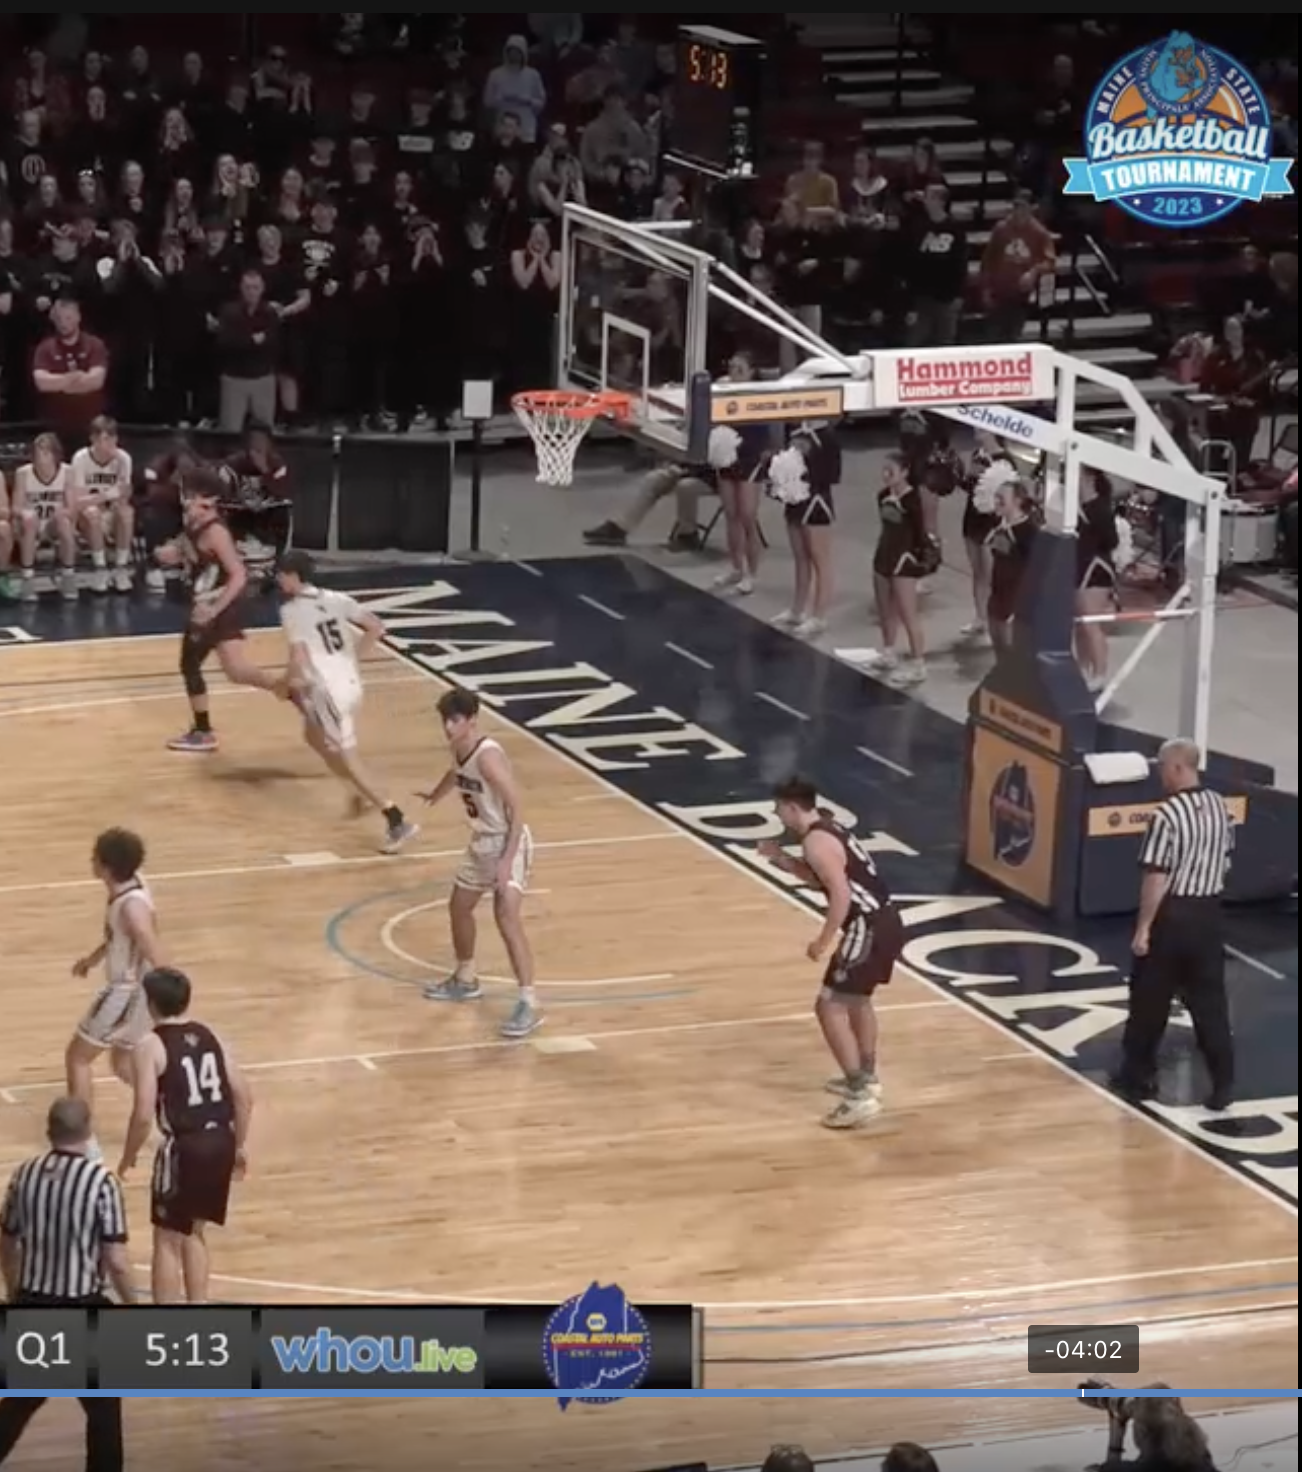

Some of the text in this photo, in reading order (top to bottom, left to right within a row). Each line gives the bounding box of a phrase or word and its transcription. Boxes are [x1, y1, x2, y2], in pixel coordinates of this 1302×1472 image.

[690, 44, 728, 89] 5:13
[897, 351, 1034, 381] Hammond
[899, 377, 1032, 399] Lumber Company
[316, 617, 345, 655] 15
[461, 793, 480, 819] 5
[181, 1052, 223, 1107] 14
